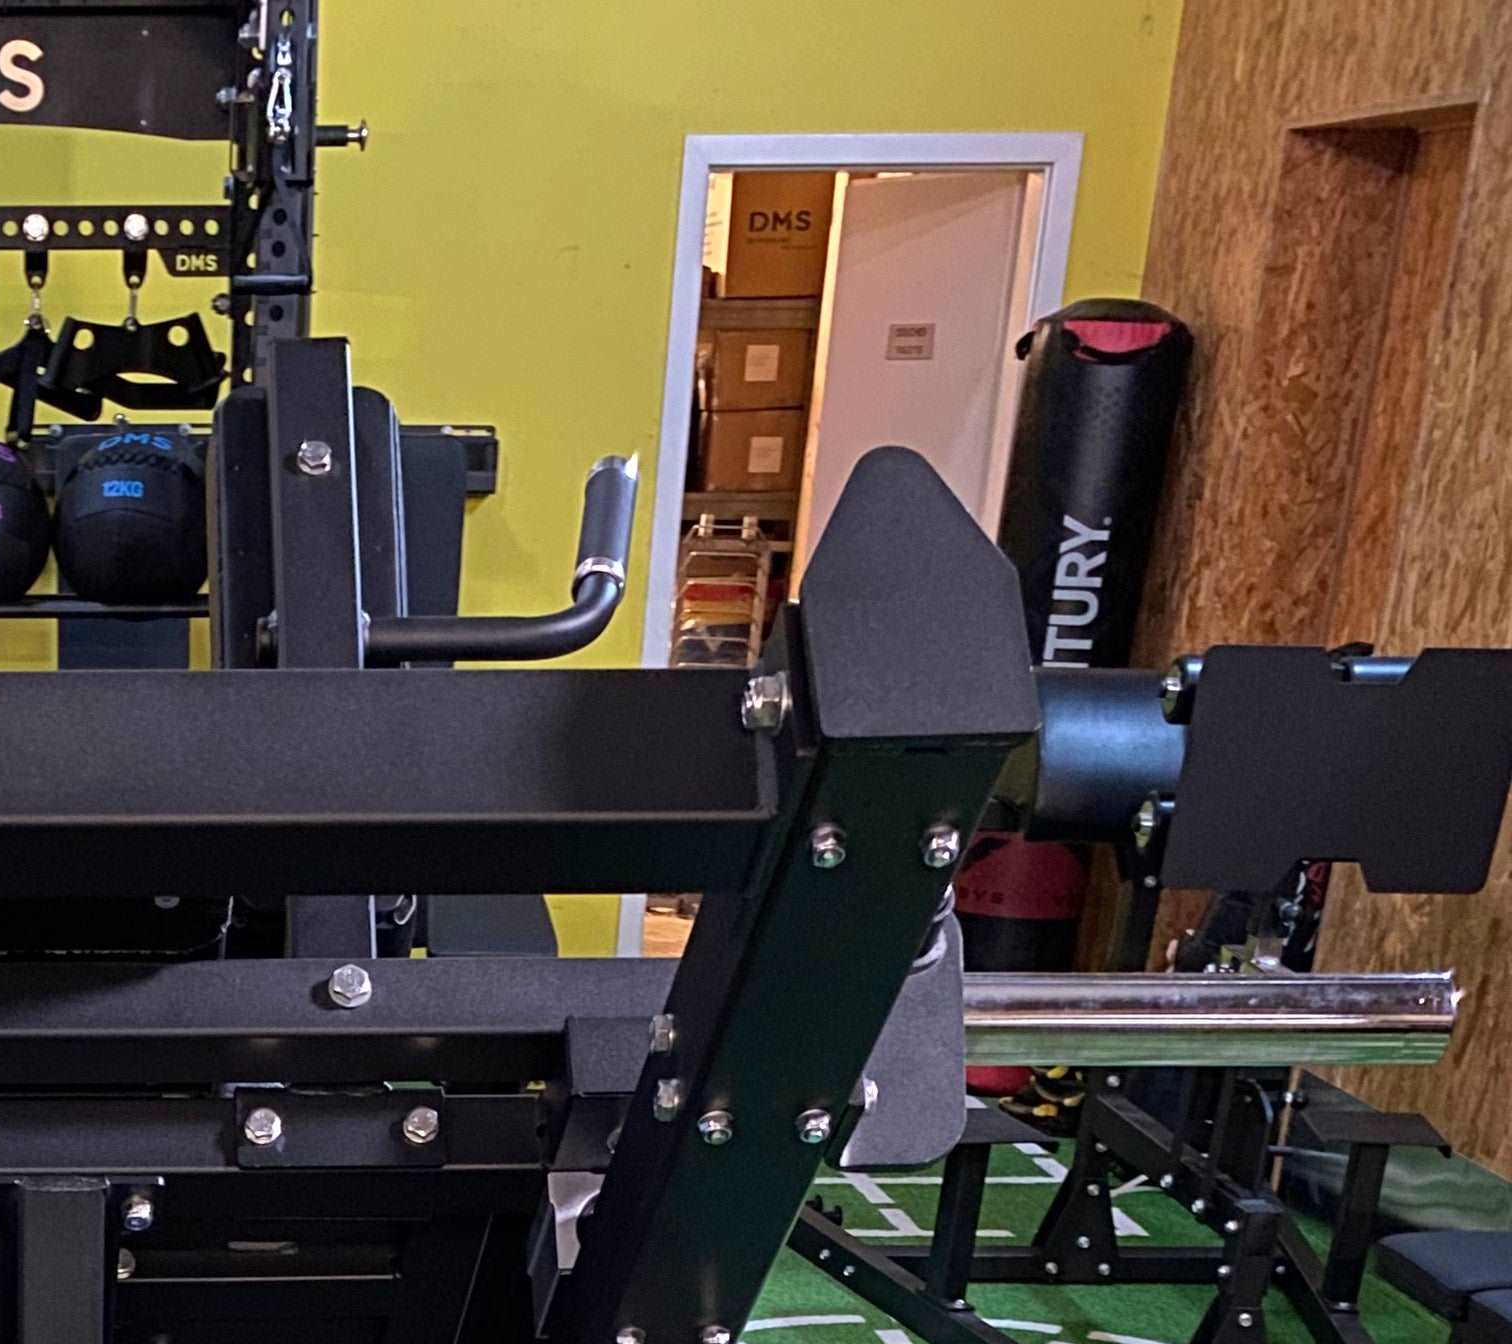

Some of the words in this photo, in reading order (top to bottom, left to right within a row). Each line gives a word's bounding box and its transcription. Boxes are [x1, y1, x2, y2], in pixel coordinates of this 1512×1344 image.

[748, 210, 812, 233] DMS
[175, 254, 219, 272] DMS
[97, 433, 174, 451] DMS
[102, 480, 145, 498] 12KG
